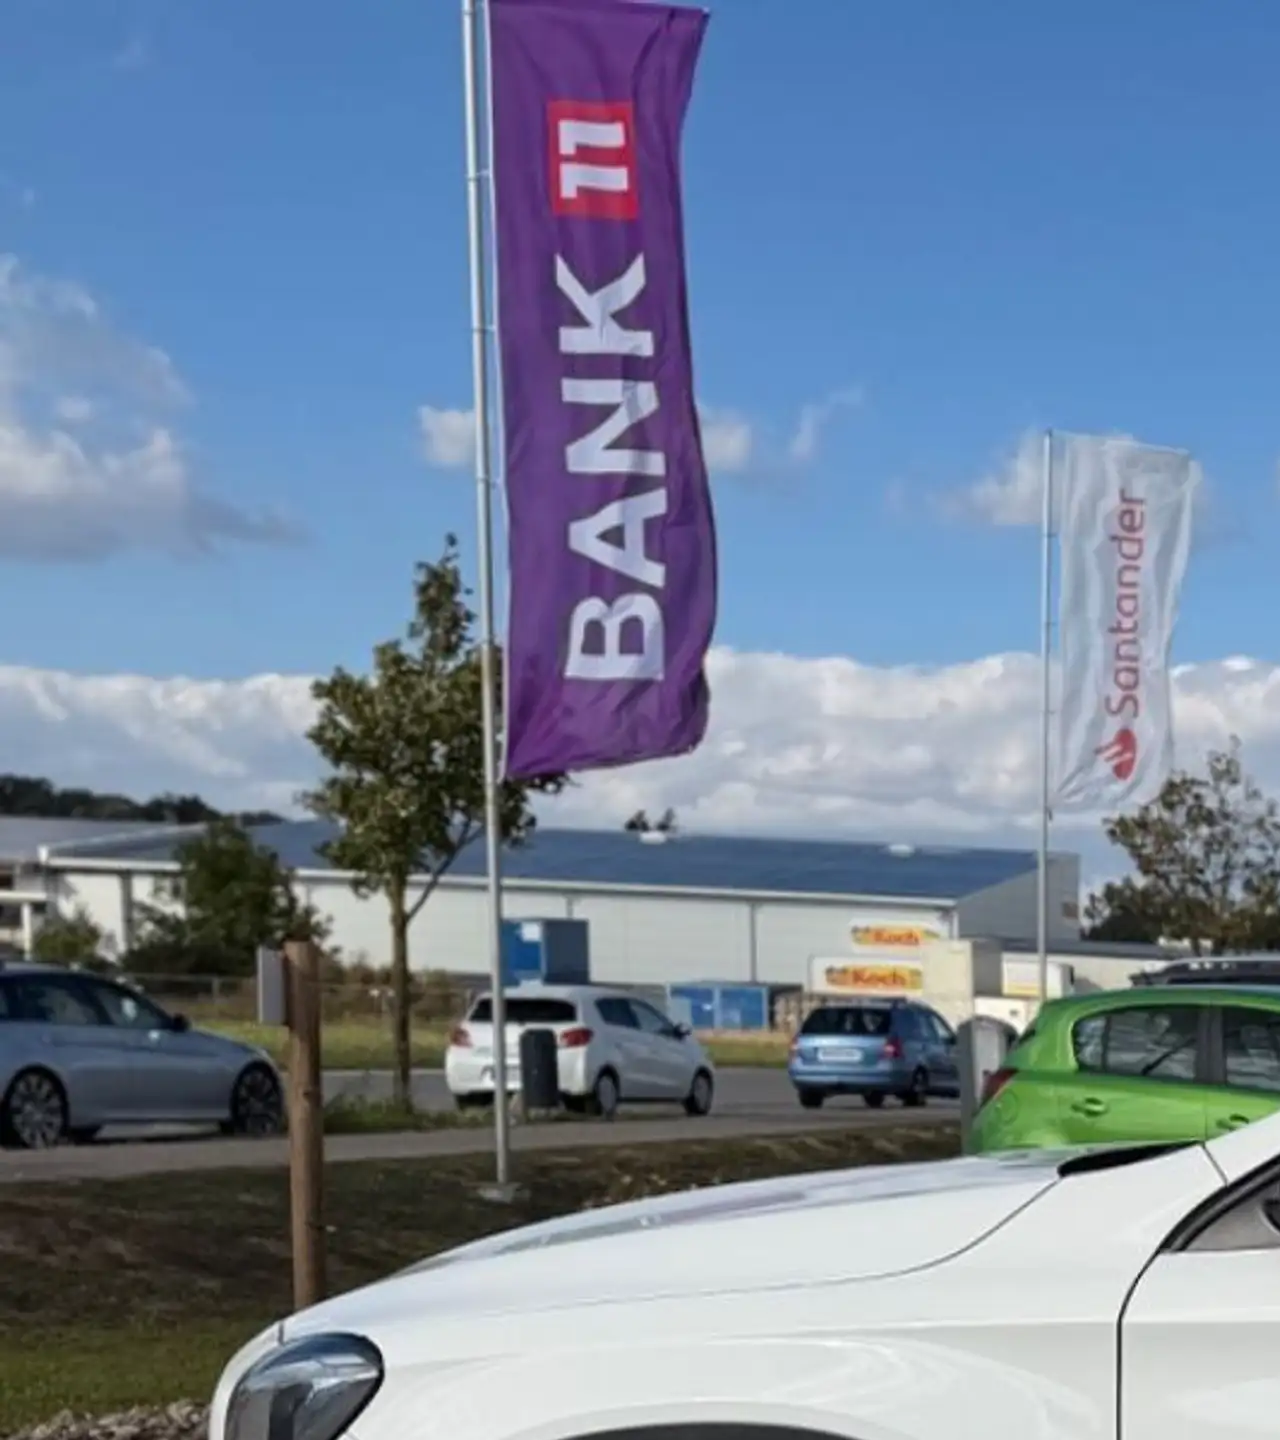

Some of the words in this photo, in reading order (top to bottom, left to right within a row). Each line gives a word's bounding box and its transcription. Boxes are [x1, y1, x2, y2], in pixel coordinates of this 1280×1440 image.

[557, 119, 632, 199] 11
[555, 253, 667, 681] BANK
[1105, 488, 1148, 719] Santander
